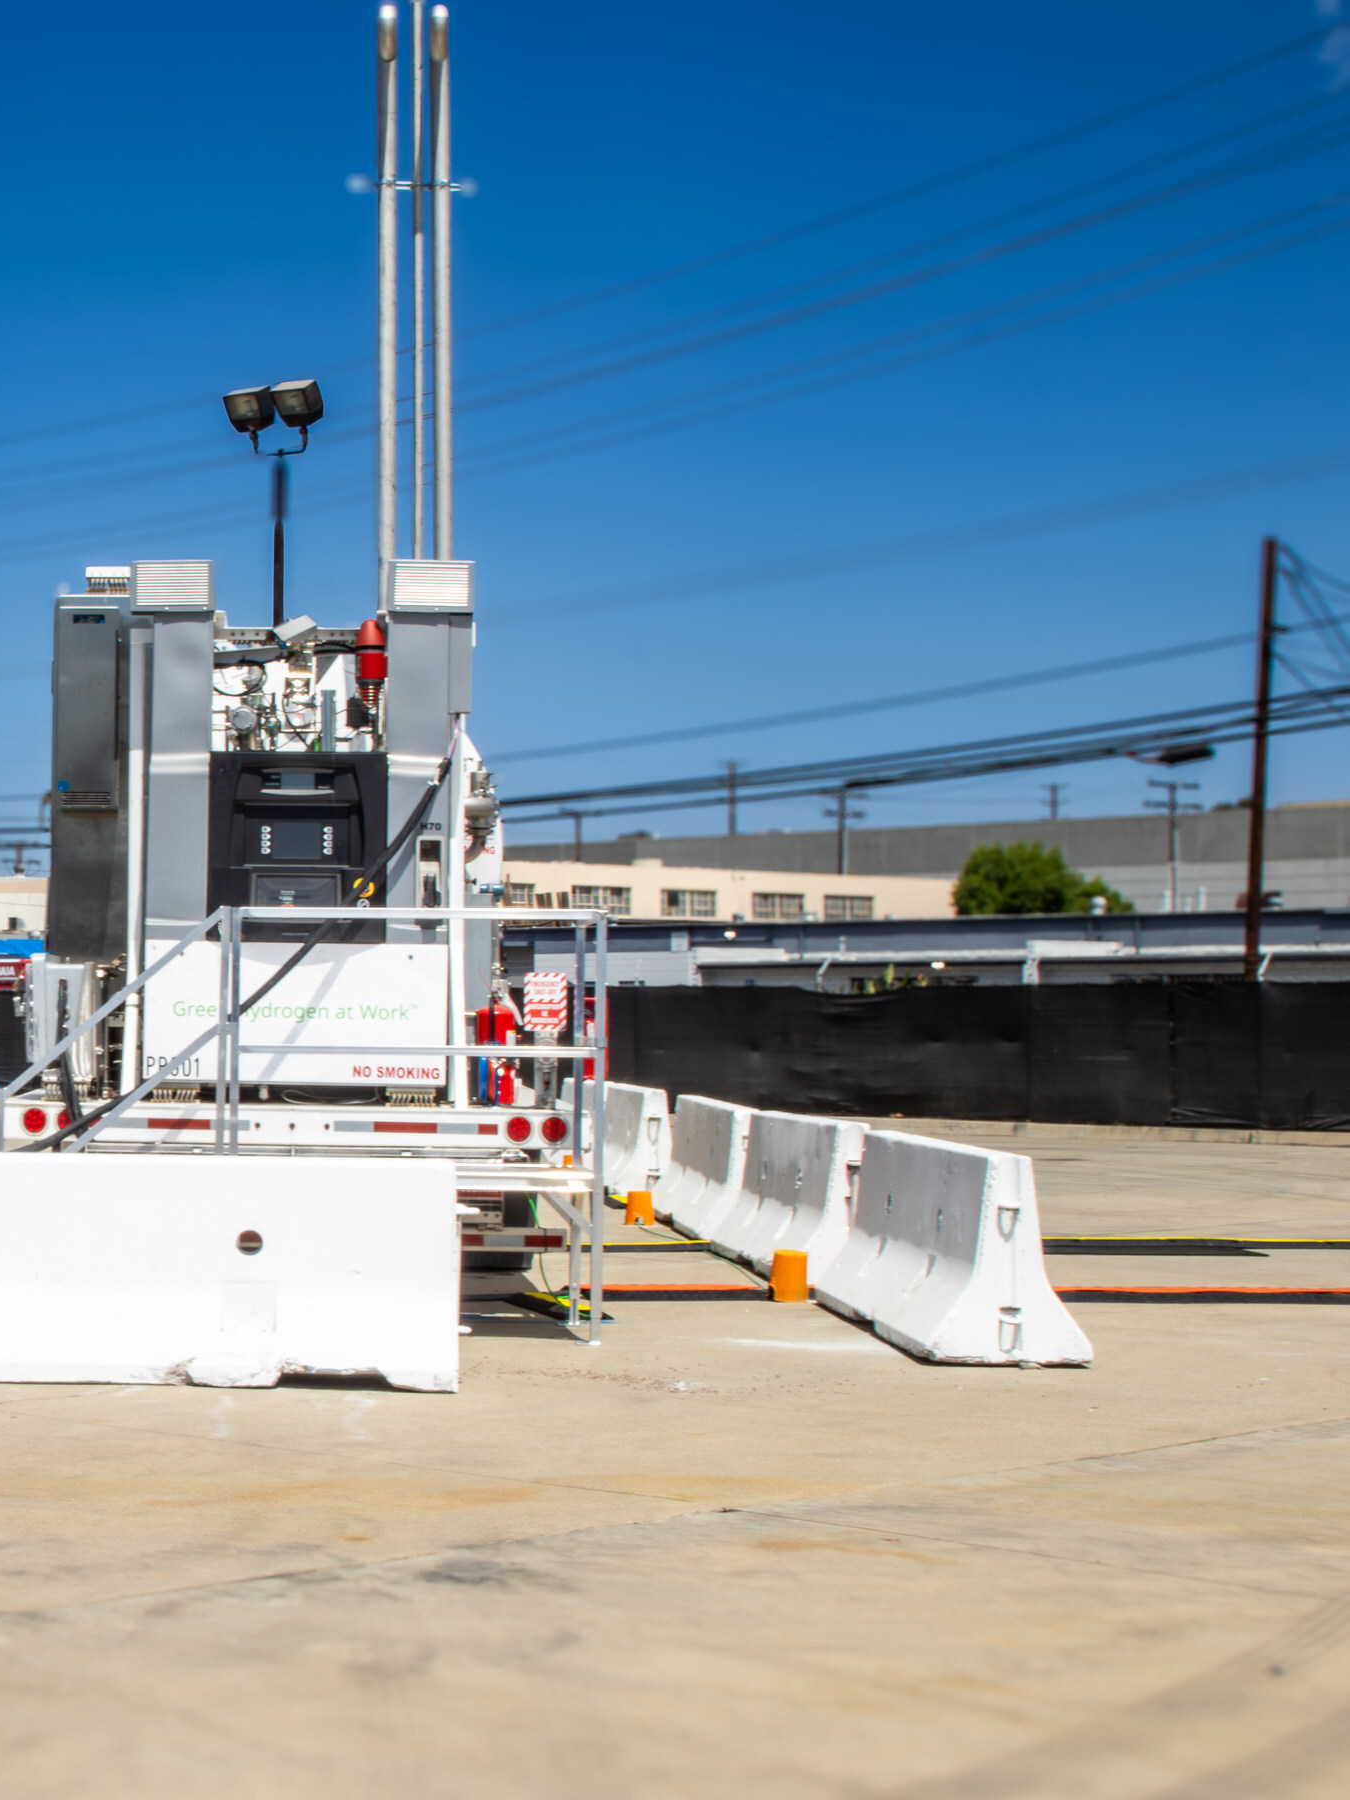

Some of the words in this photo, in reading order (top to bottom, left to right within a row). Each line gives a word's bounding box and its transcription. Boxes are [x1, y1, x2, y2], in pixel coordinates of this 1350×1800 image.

[173, 1001, 219, 1017] Gree
[246, 1002, 329, 1023] ydrogen
[336, 1004, 353, 1019] at
[352, 1066, 372, 1078] NO
[376, 1066, 441, 1080] SMOKING
